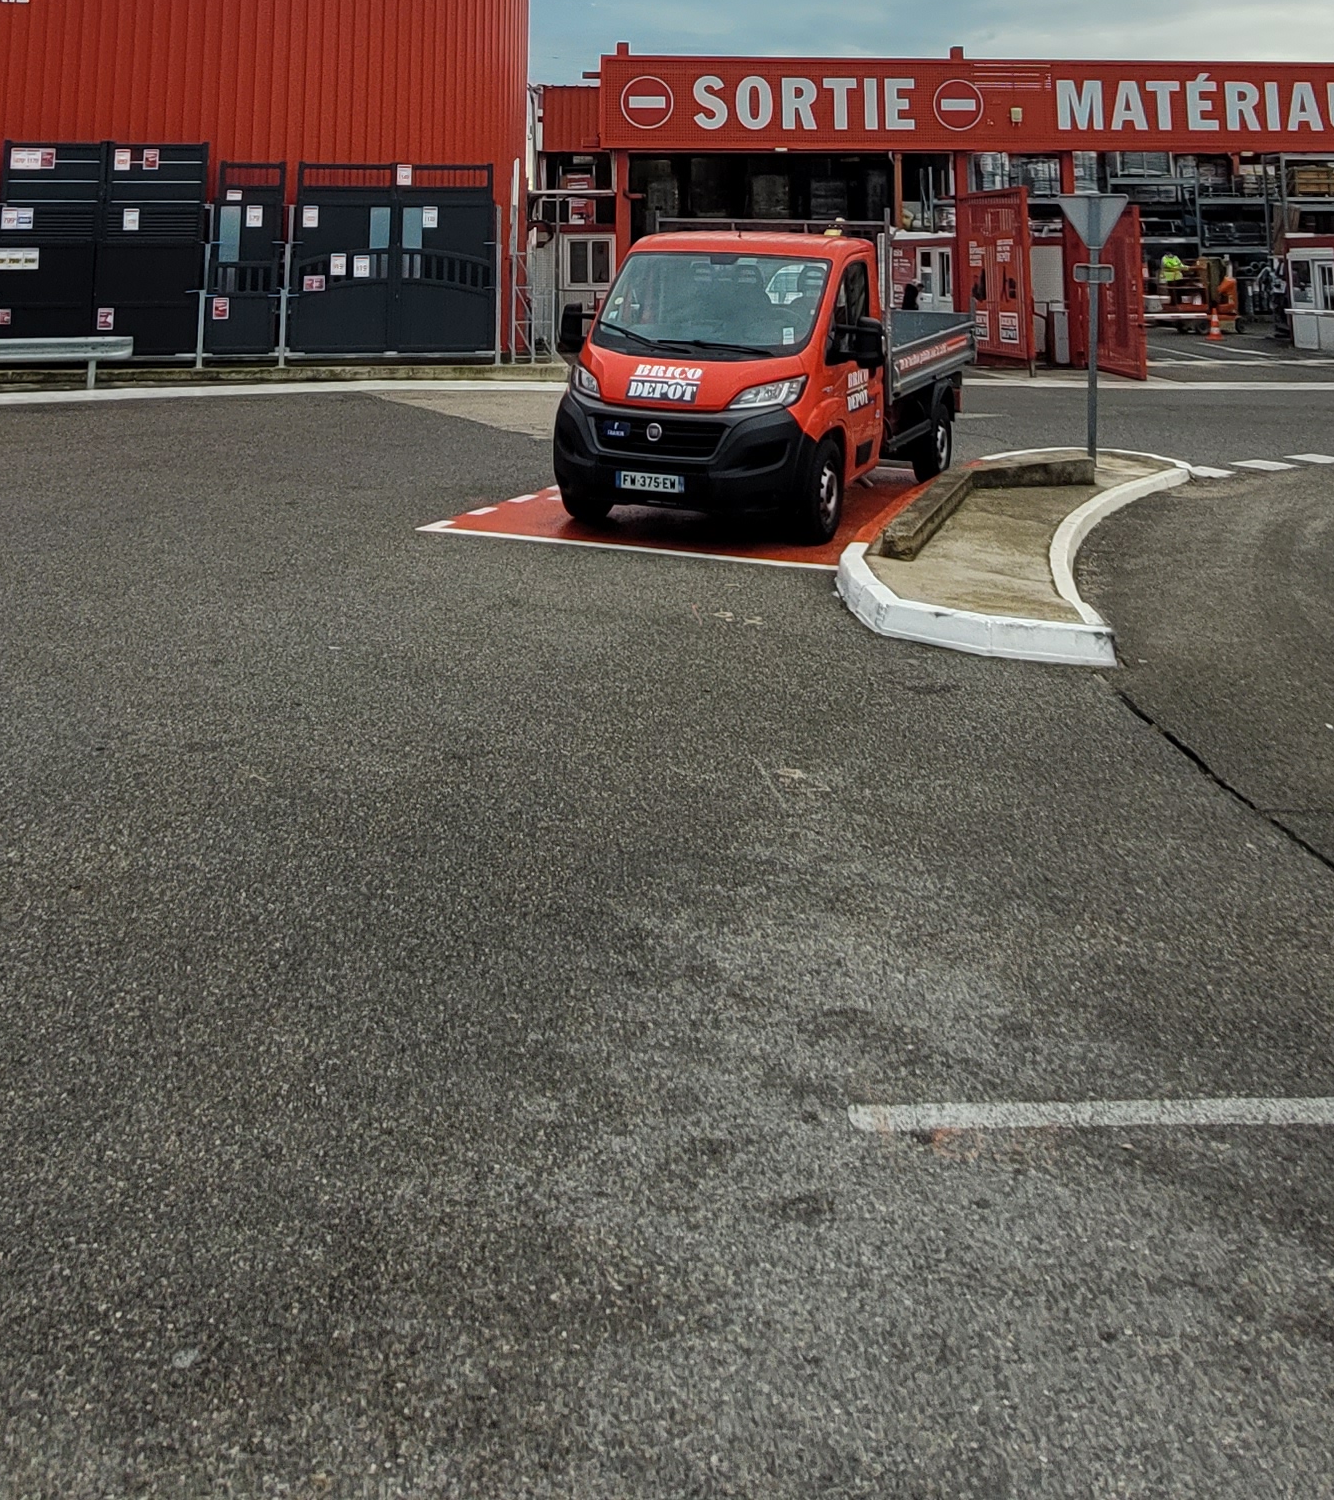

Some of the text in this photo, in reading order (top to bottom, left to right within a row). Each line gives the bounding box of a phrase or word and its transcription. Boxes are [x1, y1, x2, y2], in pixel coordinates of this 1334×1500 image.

[693, 75, 917, 132] SORTIE
[634, 363, 704, 379] BRICO
[627, 380, 698, 401] DEPÔT
